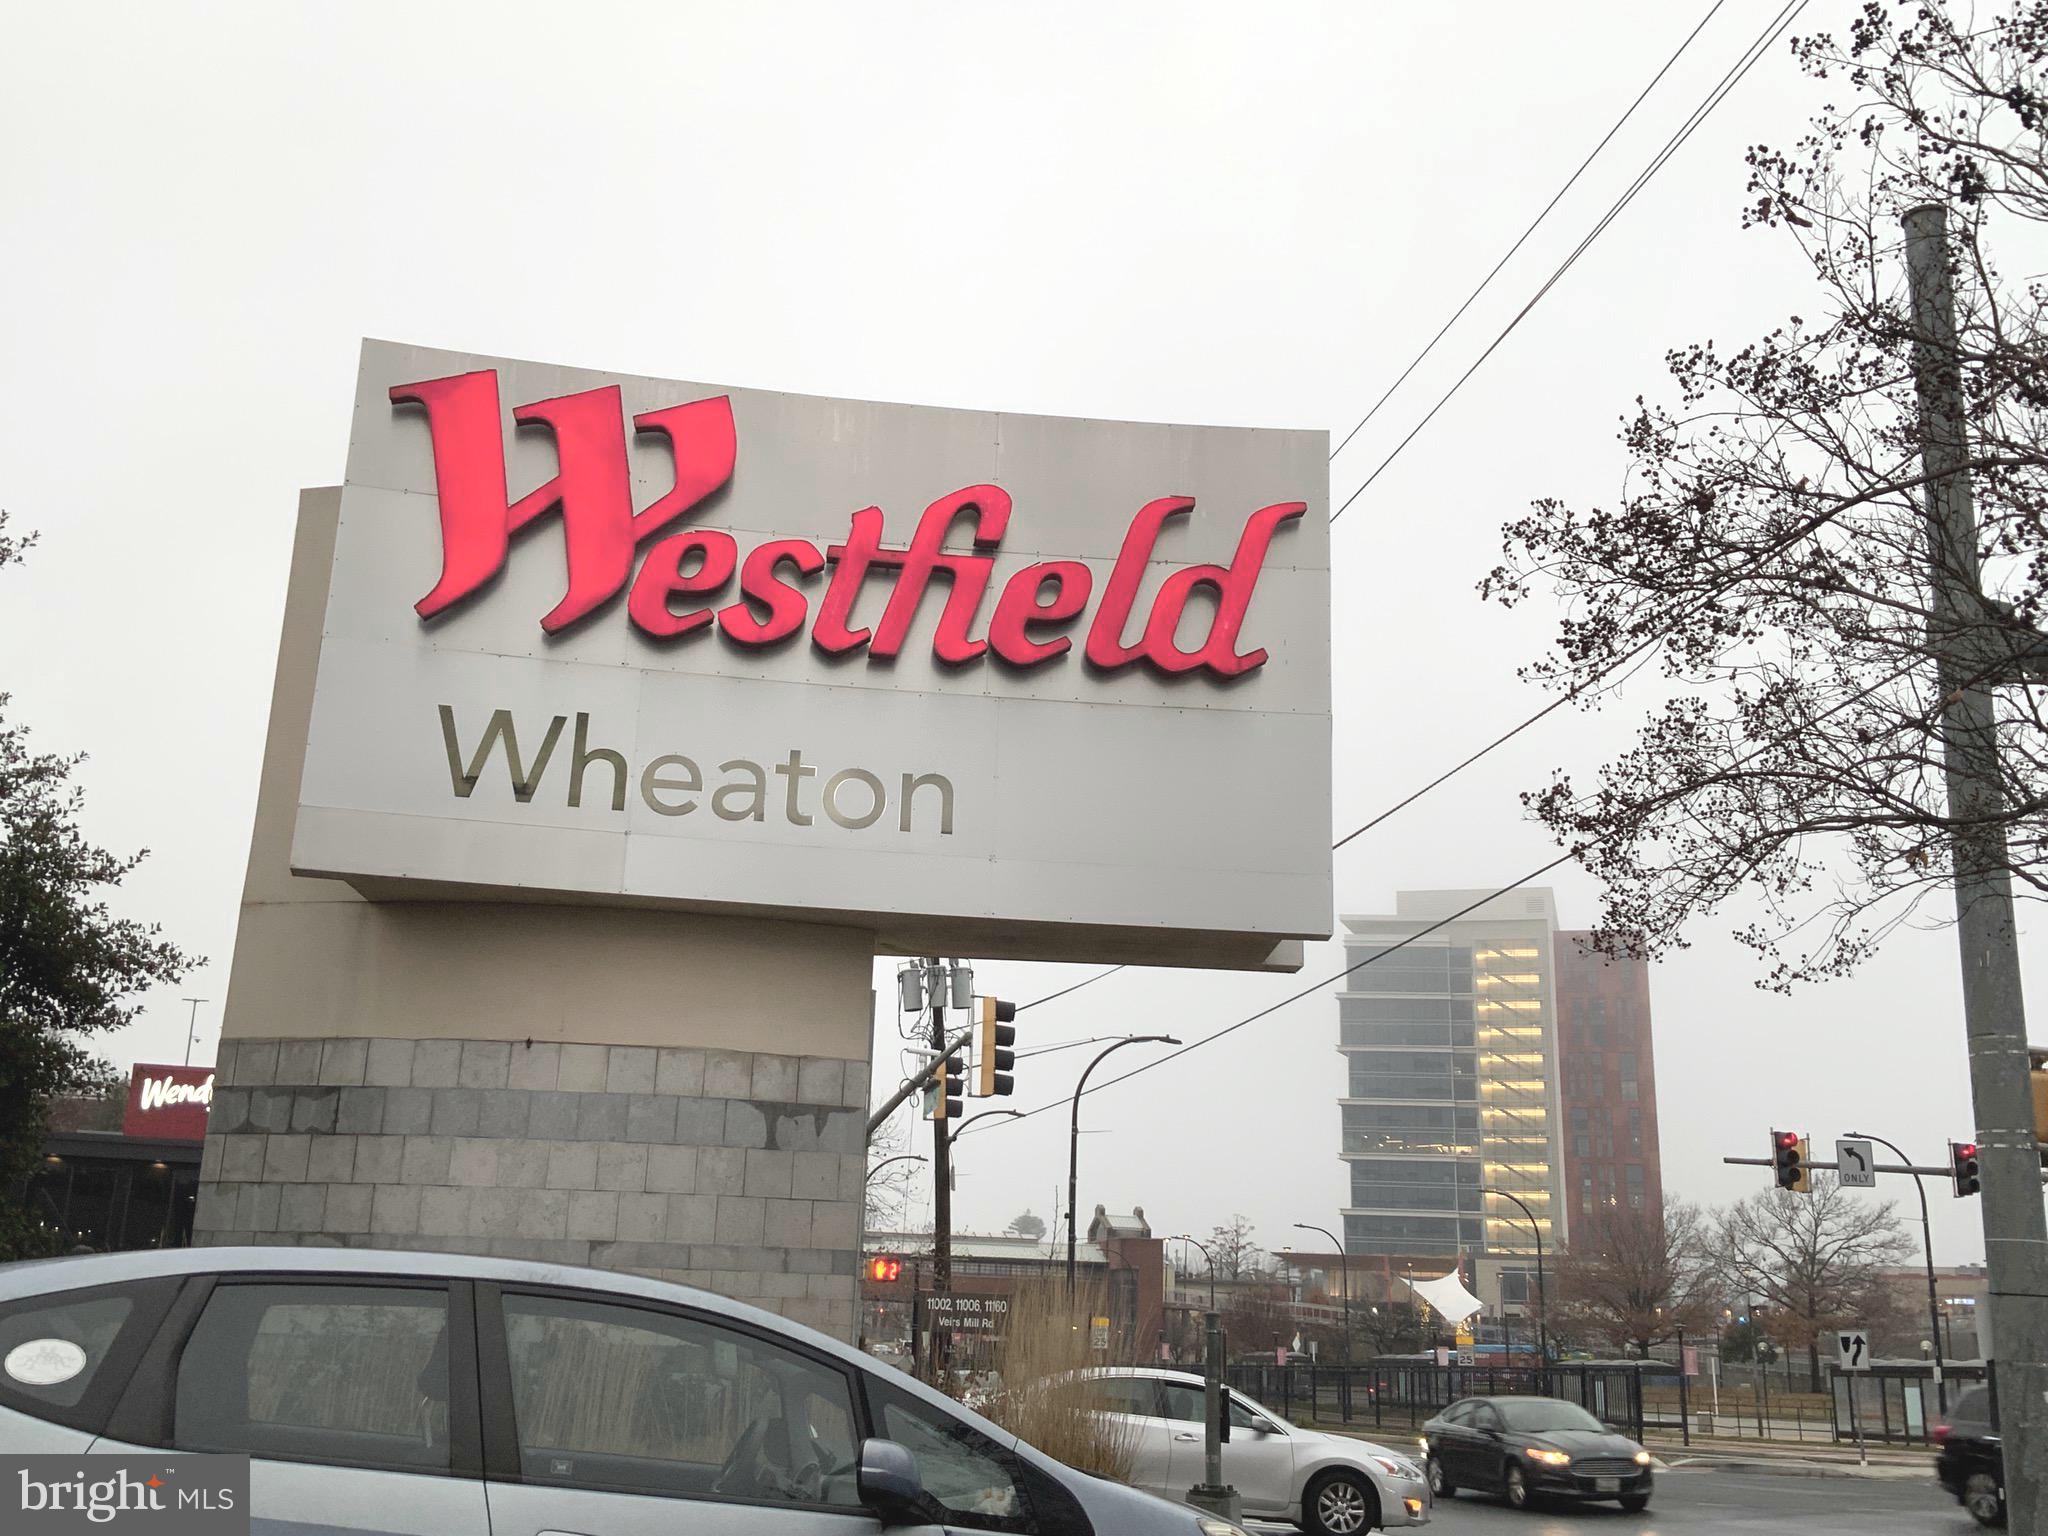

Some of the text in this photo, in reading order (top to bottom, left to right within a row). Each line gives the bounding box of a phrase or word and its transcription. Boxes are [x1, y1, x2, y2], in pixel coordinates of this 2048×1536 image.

[389, 370, 1307, 678] Westfield
[438, 703, 955, 835] Wheaton
[1844, 1173, 1869, 1183] ONLY
[927, 1297, 1007, 1314] 11002, 11006, 11160
[963, 1318, 979, 1328] Mill
[1460, 1355, 1473, 1364] 25
